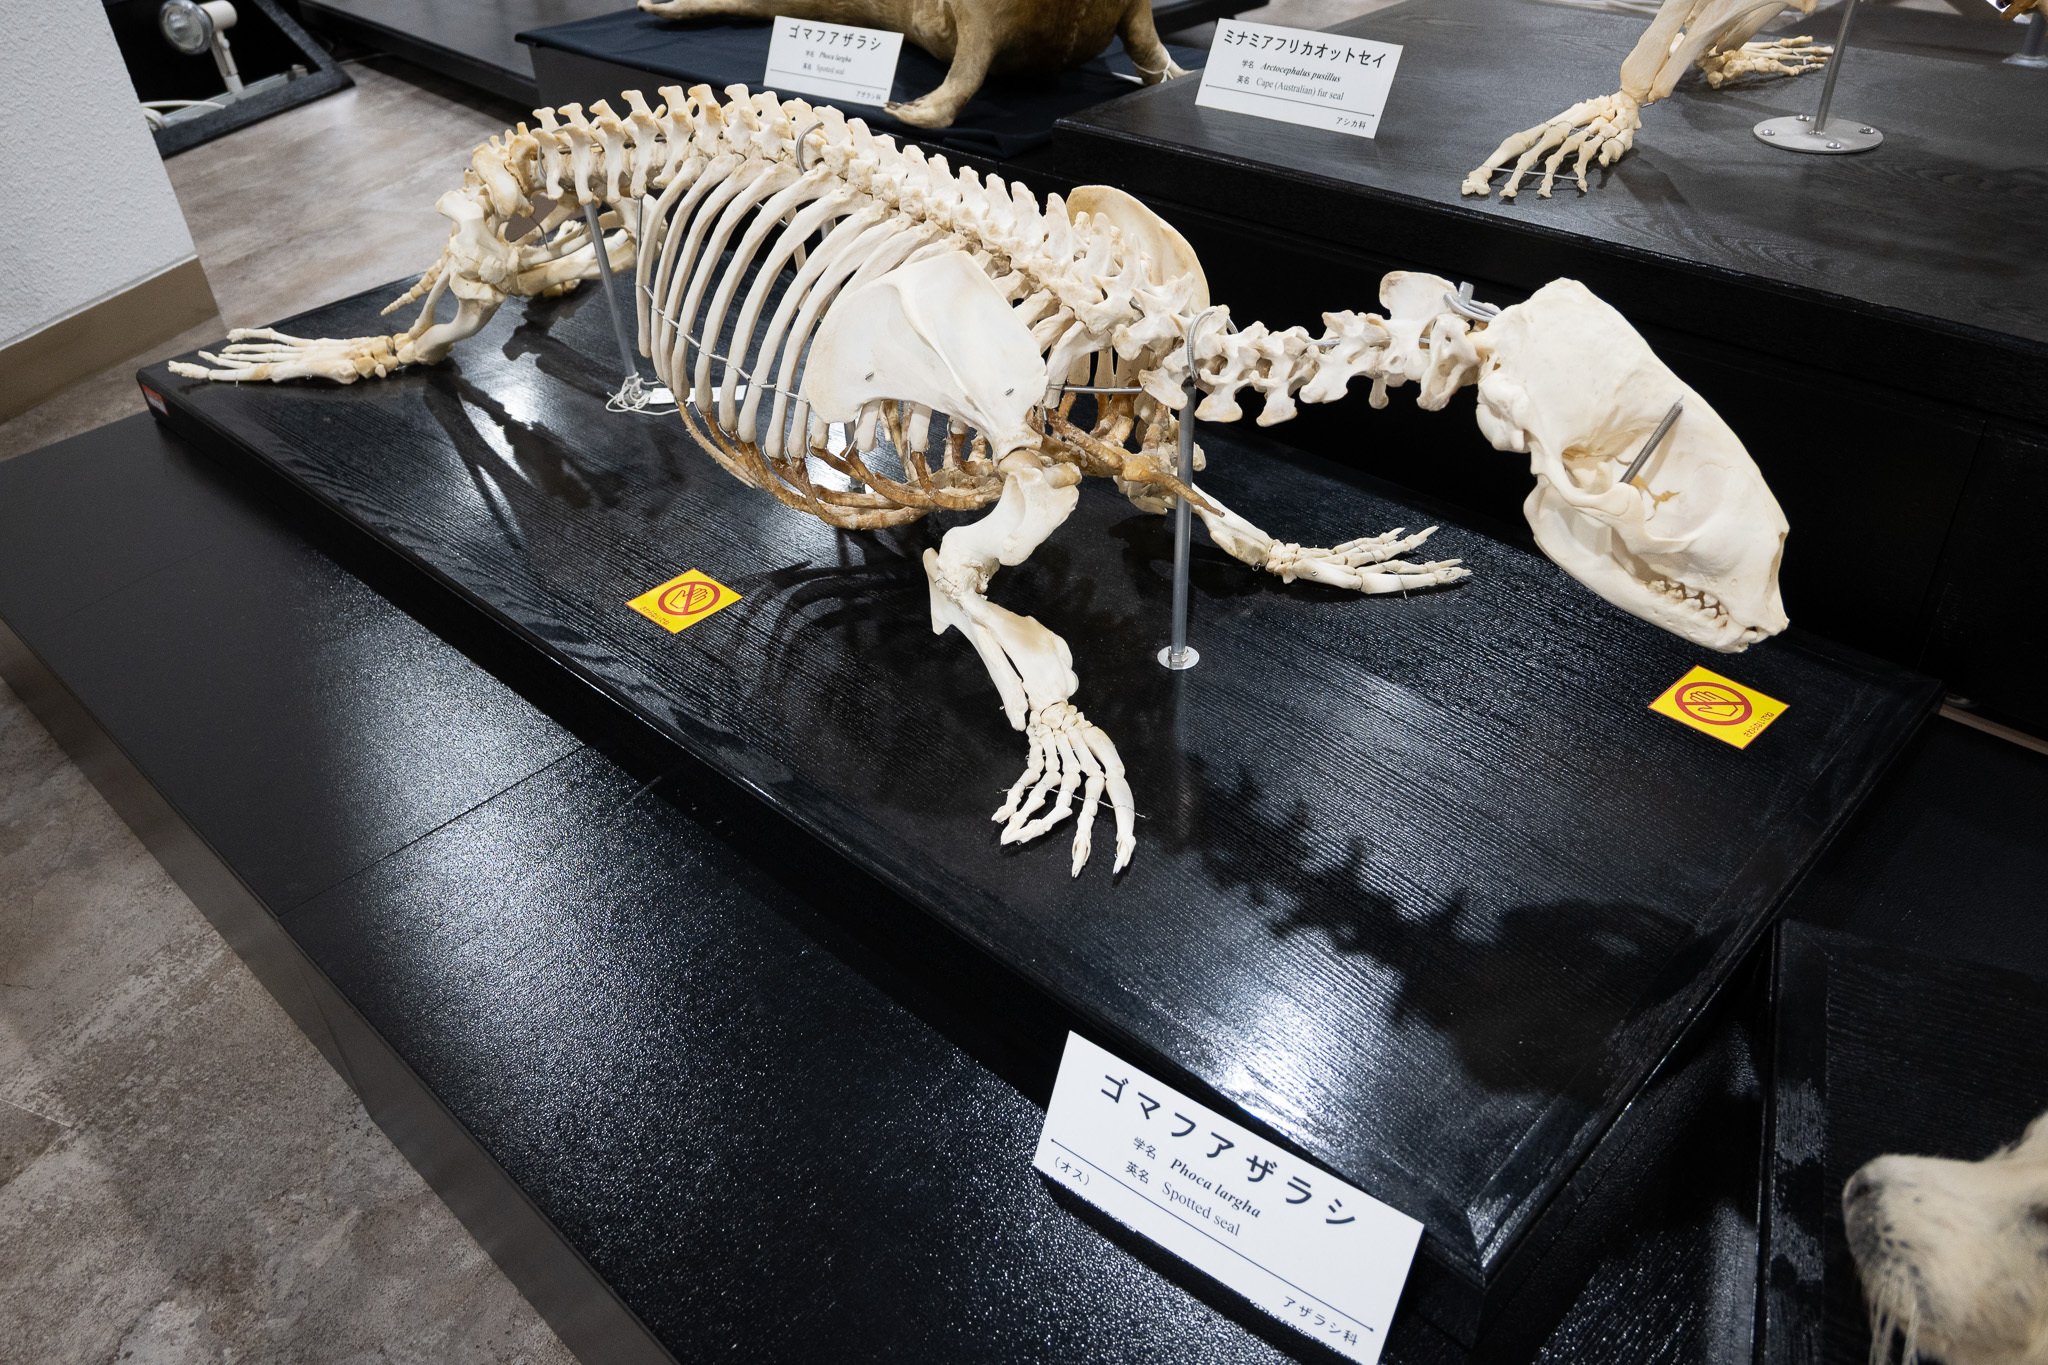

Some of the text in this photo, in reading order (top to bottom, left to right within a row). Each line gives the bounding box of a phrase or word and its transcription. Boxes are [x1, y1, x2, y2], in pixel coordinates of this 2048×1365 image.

[788, 25, 882, 51] ゴマフアザラシ
[1223, 29, 1387, 69] ミナミアフリカオットセイ
[1236, 75, 1345, 101] 英名 Cape (Australian) fur seal
[1241, 60, 1342, 83] 学名 Arctocephalus pusillus
[1336, 116, 1366, 129] アシカ科
[1100, 1073, 1356, 1226] ゴマフアザラシ
[1132, 1136, 1262, 1220] 学名 Phoca largha
[1125, 1160, 1240, 1237] 英名 Spotted seal
[1283, 1296, 1358, 1346] アザラシ科
